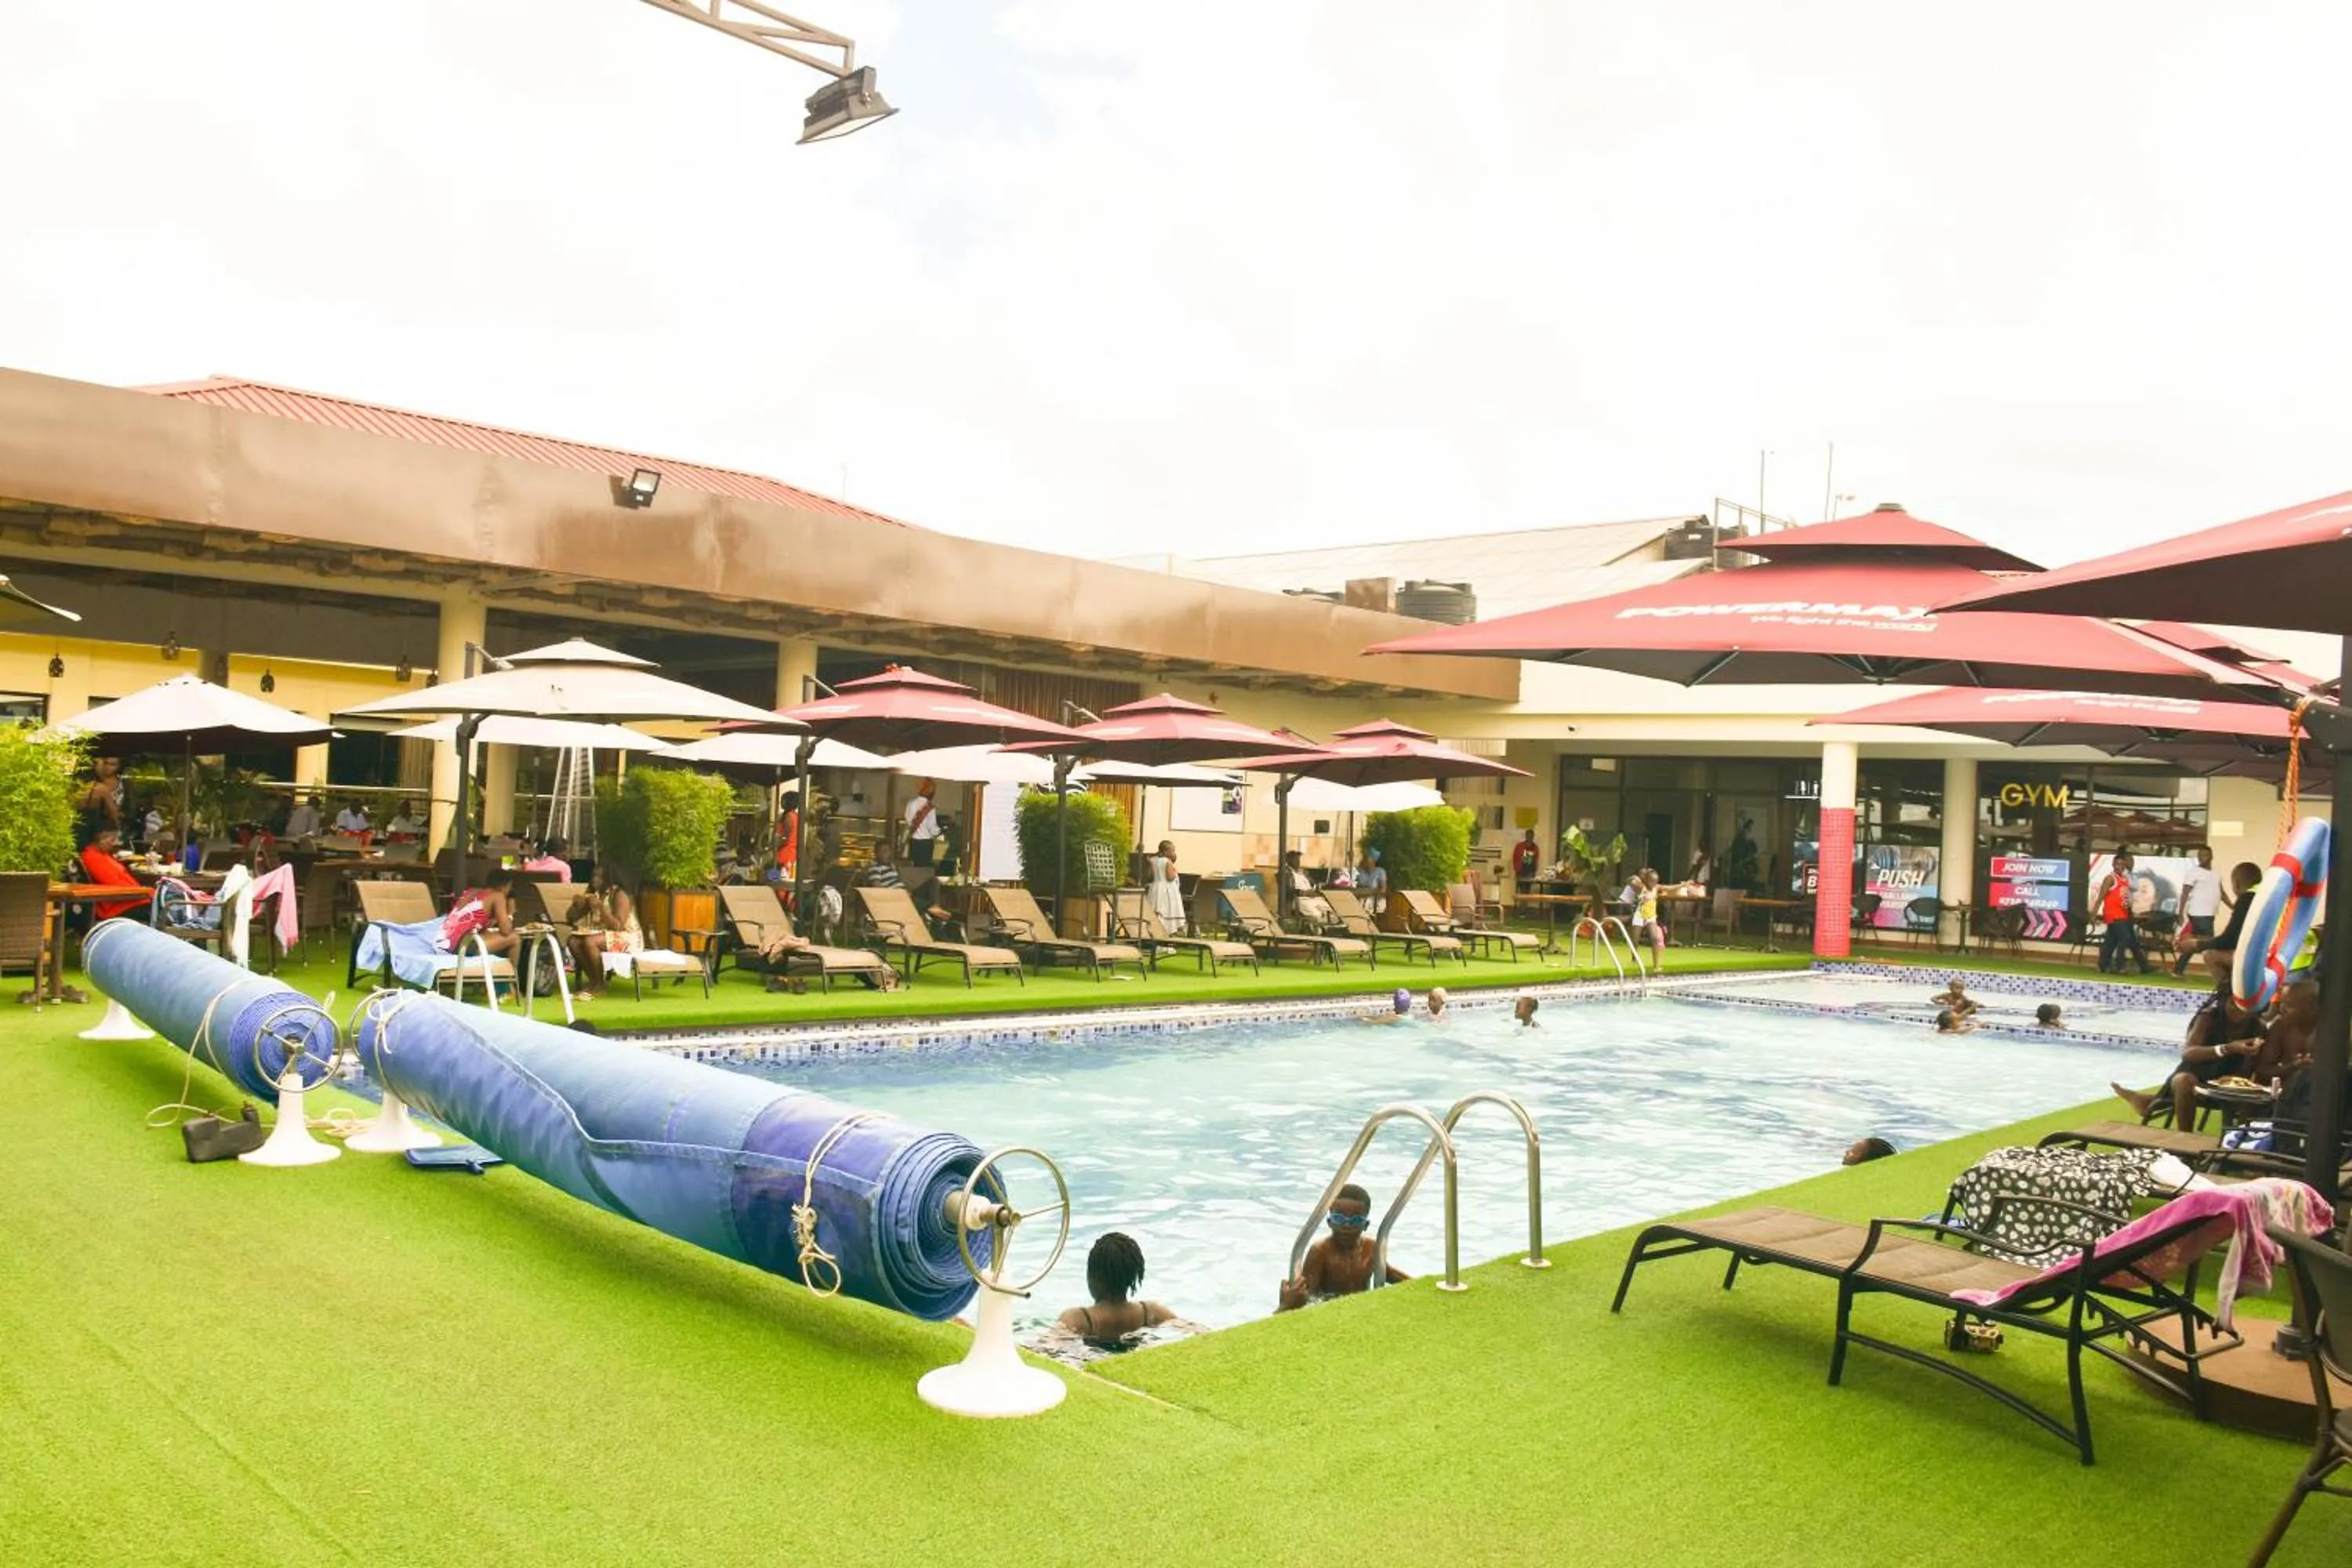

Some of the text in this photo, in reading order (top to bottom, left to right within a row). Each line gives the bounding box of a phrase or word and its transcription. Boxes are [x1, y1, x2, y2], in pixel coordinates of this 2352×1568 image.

[1614, 601, 1938, 620] POWERMAX
[2001, 782, 2067, 808] GYM
[2002, 862, 2057, 874] JOIN NOW
[1876, 869, 1924, 889] PUSH
[2014, 886, 2040, 897] CALL
